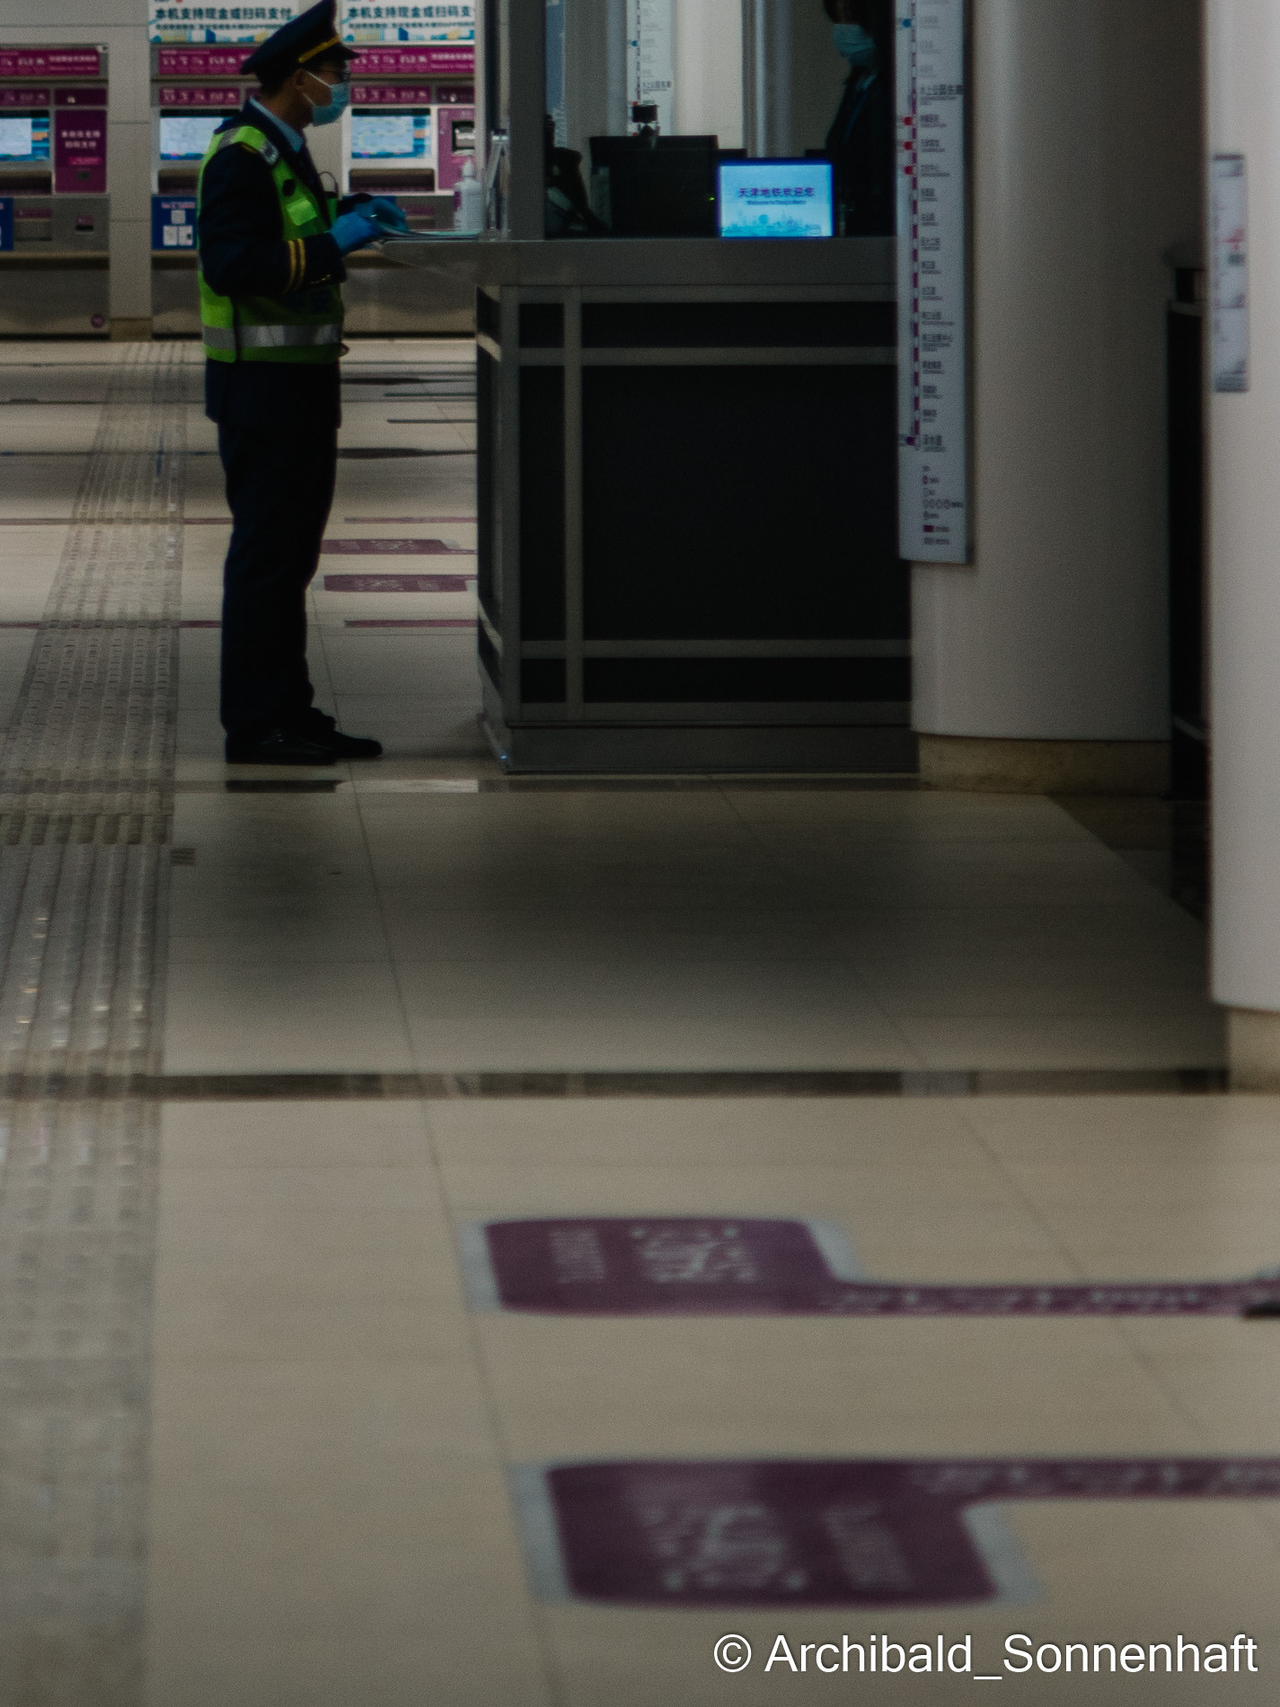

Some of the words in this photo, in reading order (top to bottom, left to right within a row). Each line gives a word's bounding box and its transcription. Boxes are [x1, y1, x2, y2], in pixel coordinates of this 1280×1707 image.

[348, 6, 475, 18] 本机支持现金或扫码支
